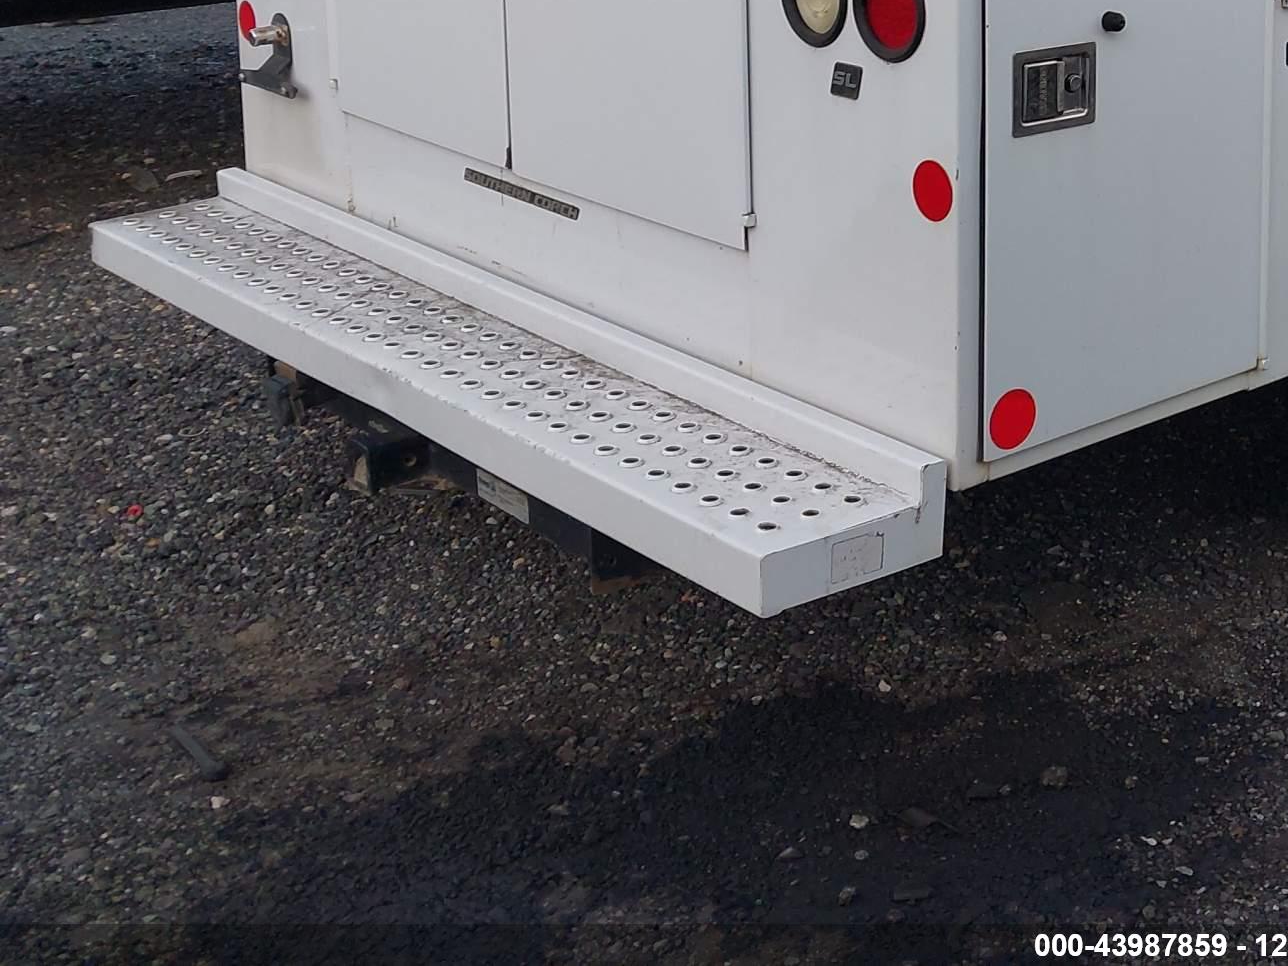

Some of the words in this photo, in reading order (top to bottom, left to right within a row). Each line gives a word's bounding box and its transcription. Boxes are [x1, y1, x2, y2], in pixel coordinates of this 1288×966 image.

[833, 71, 857, 89] SL
[465, 169, 532, 203] SOUTHERN
[533, 193, 578, 219] COACH
